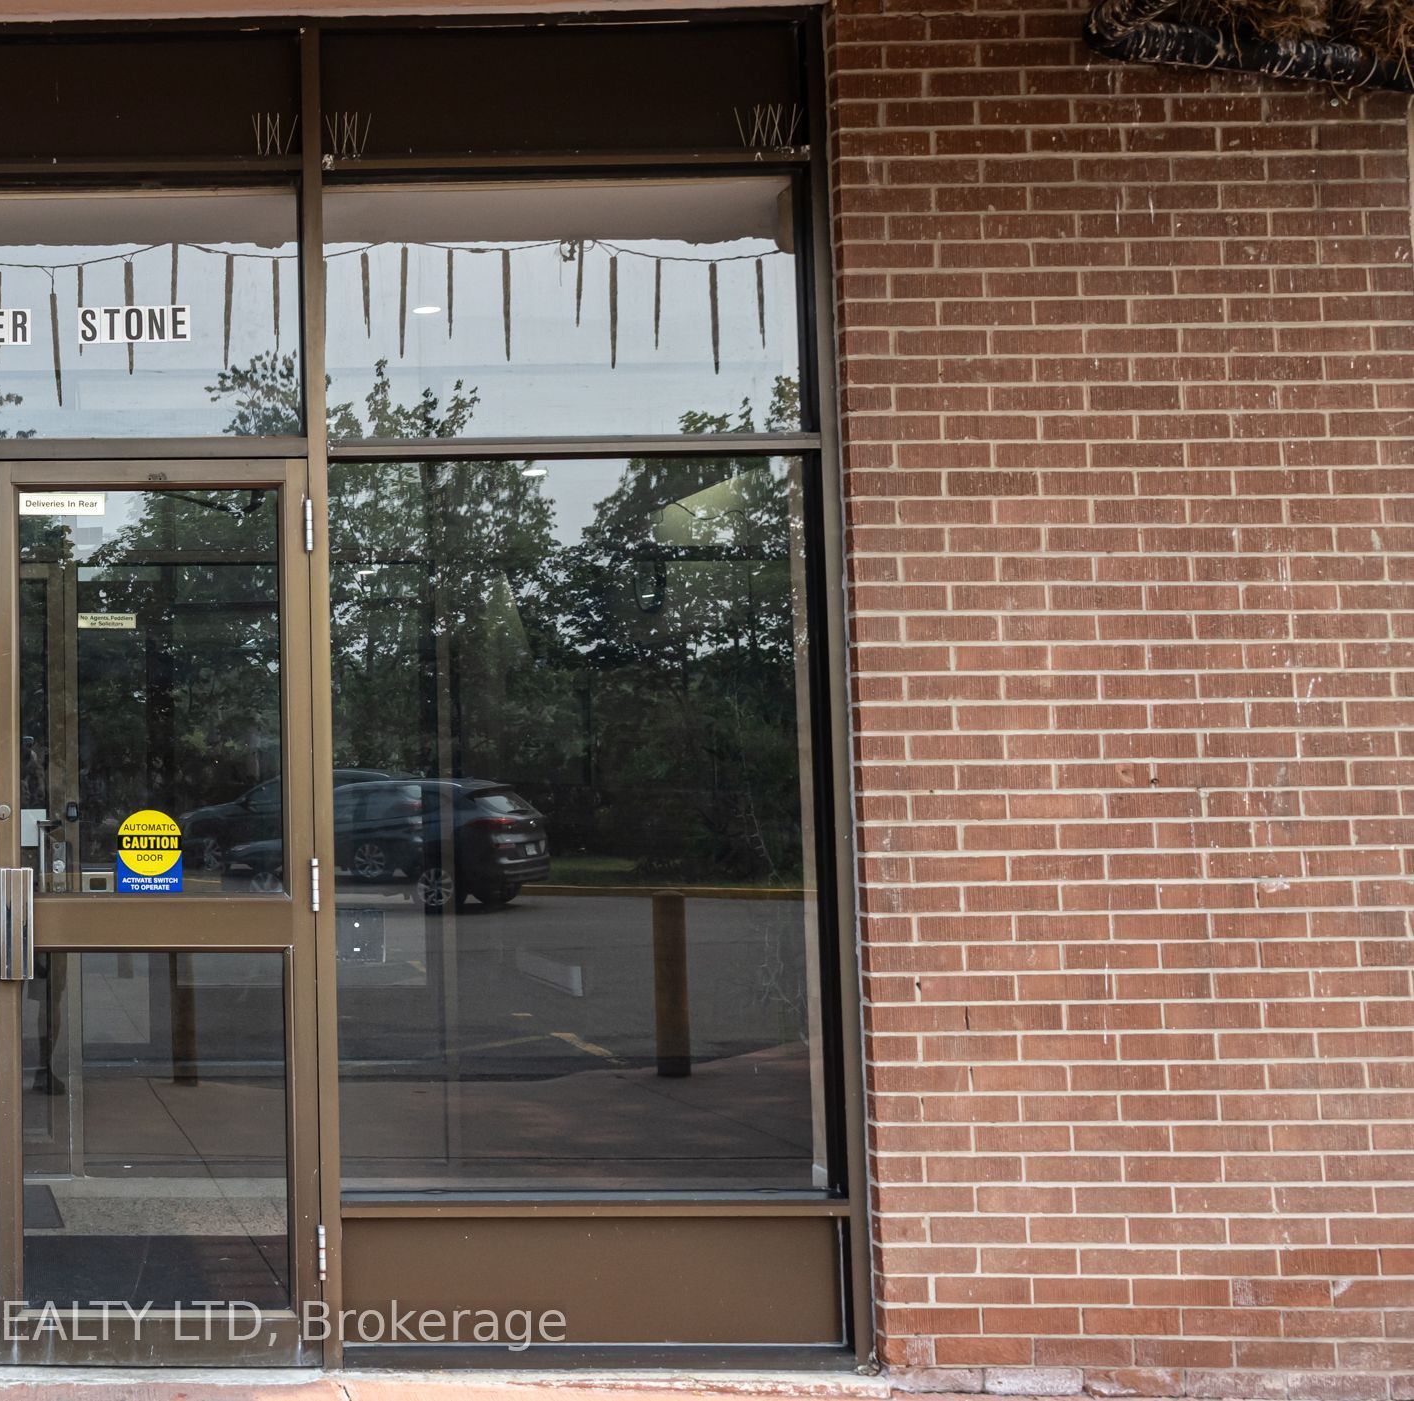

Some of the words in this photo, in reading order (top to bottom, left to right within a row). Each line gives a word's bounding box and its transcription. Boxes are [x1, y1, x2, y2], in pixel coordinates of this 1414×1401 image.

[80, 307, 188, 342] STONE
[25, 500, 65, 508] Deliveries
[67, 500, 76, 508] In
[78, 500, 98, 508] Rear
[123, 823, 176, 832] AUTOMATIC
[122, 836, 179, 849] CAUTION
[136, 854, 164, 862] DOOR
